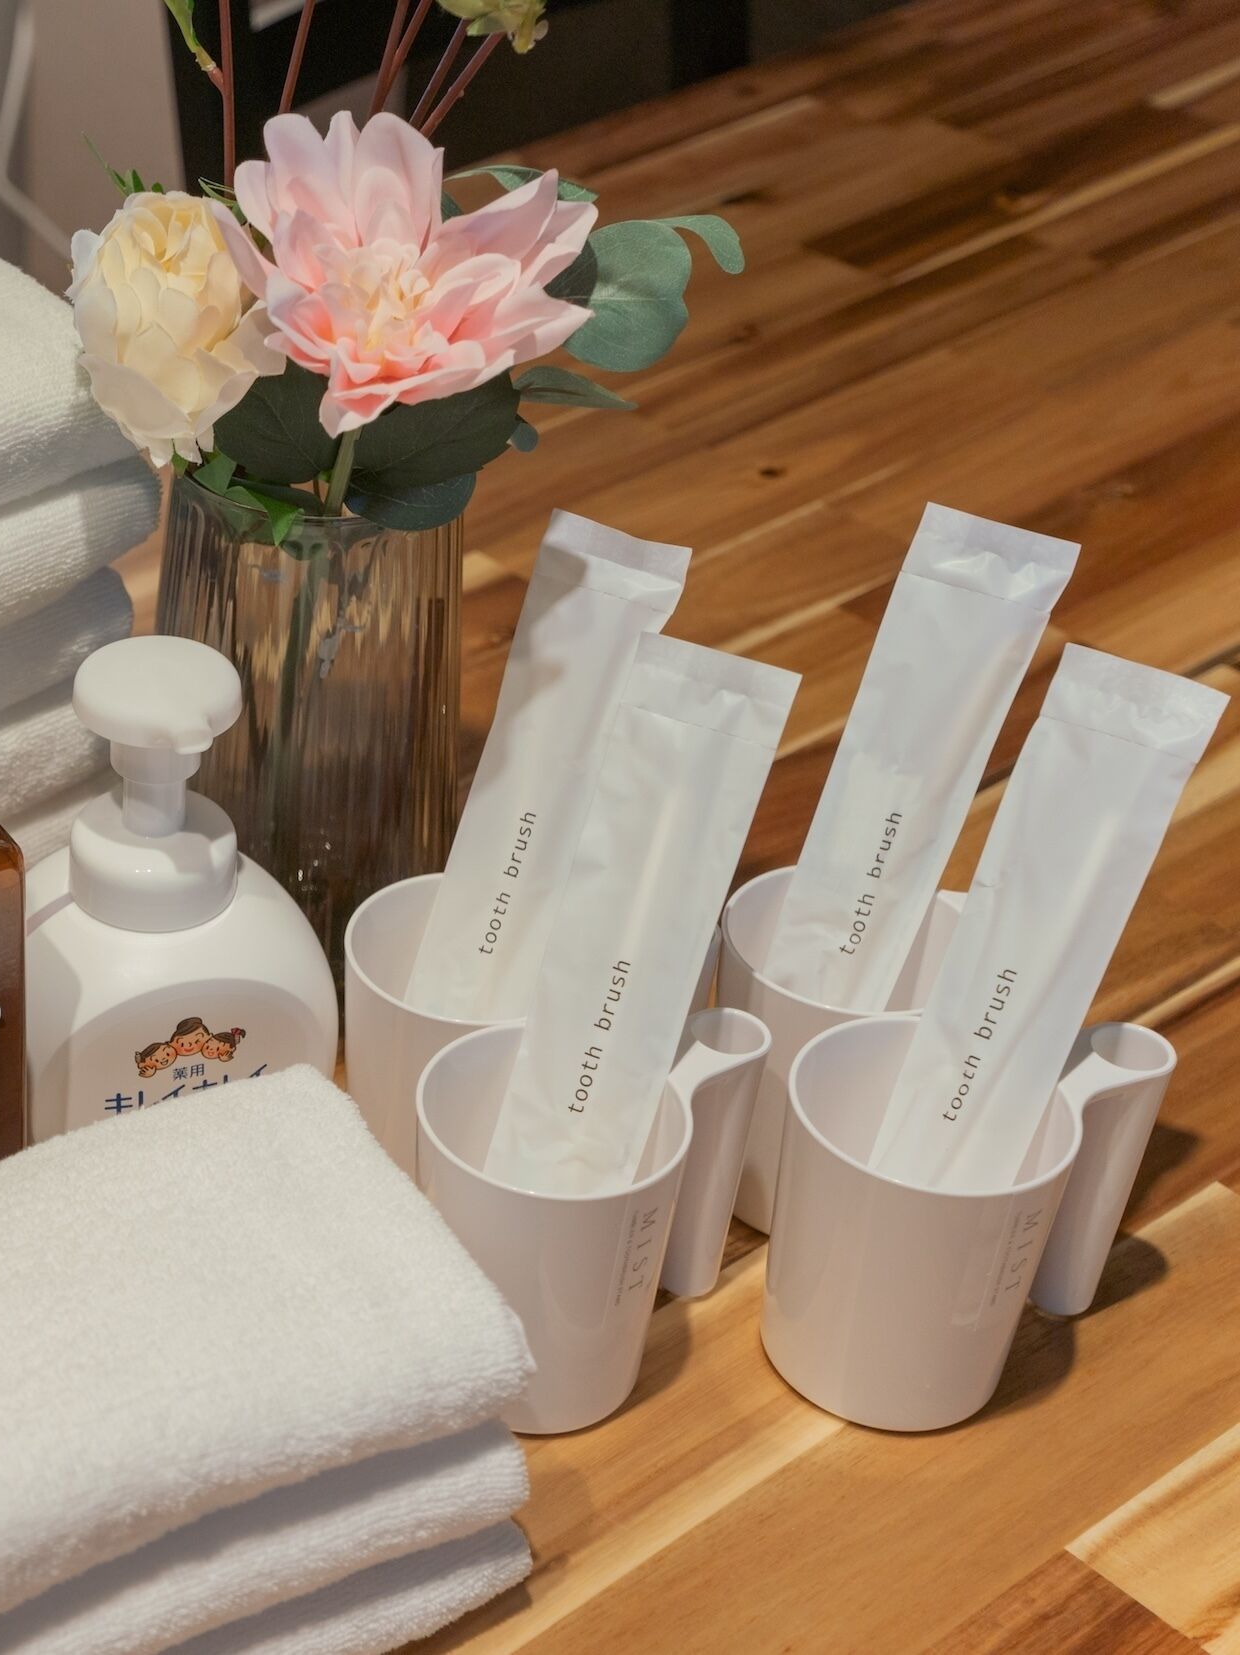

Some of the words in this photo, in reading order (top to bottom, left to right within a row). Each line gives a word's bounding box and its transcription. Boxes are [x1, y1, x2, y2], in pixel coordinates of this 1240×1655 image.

[478, 892, 511, 955] tooth
[503, 811, 537, 878] brush
[839, 893, 876, 955] tooth
[866, 811, 903, 879] brush
[172, 1063, 205, 1081] 薬用
[568, 1046, 603, 1113] tooth
[593, 960, 631, 1031] brush
[942, 1054, 981, 1122] tooth
[973, 968, 1018, 1040] brush
[628, 1207, 659, 1291] MIST
[1005, 1207, 1043, 1291] MIST
